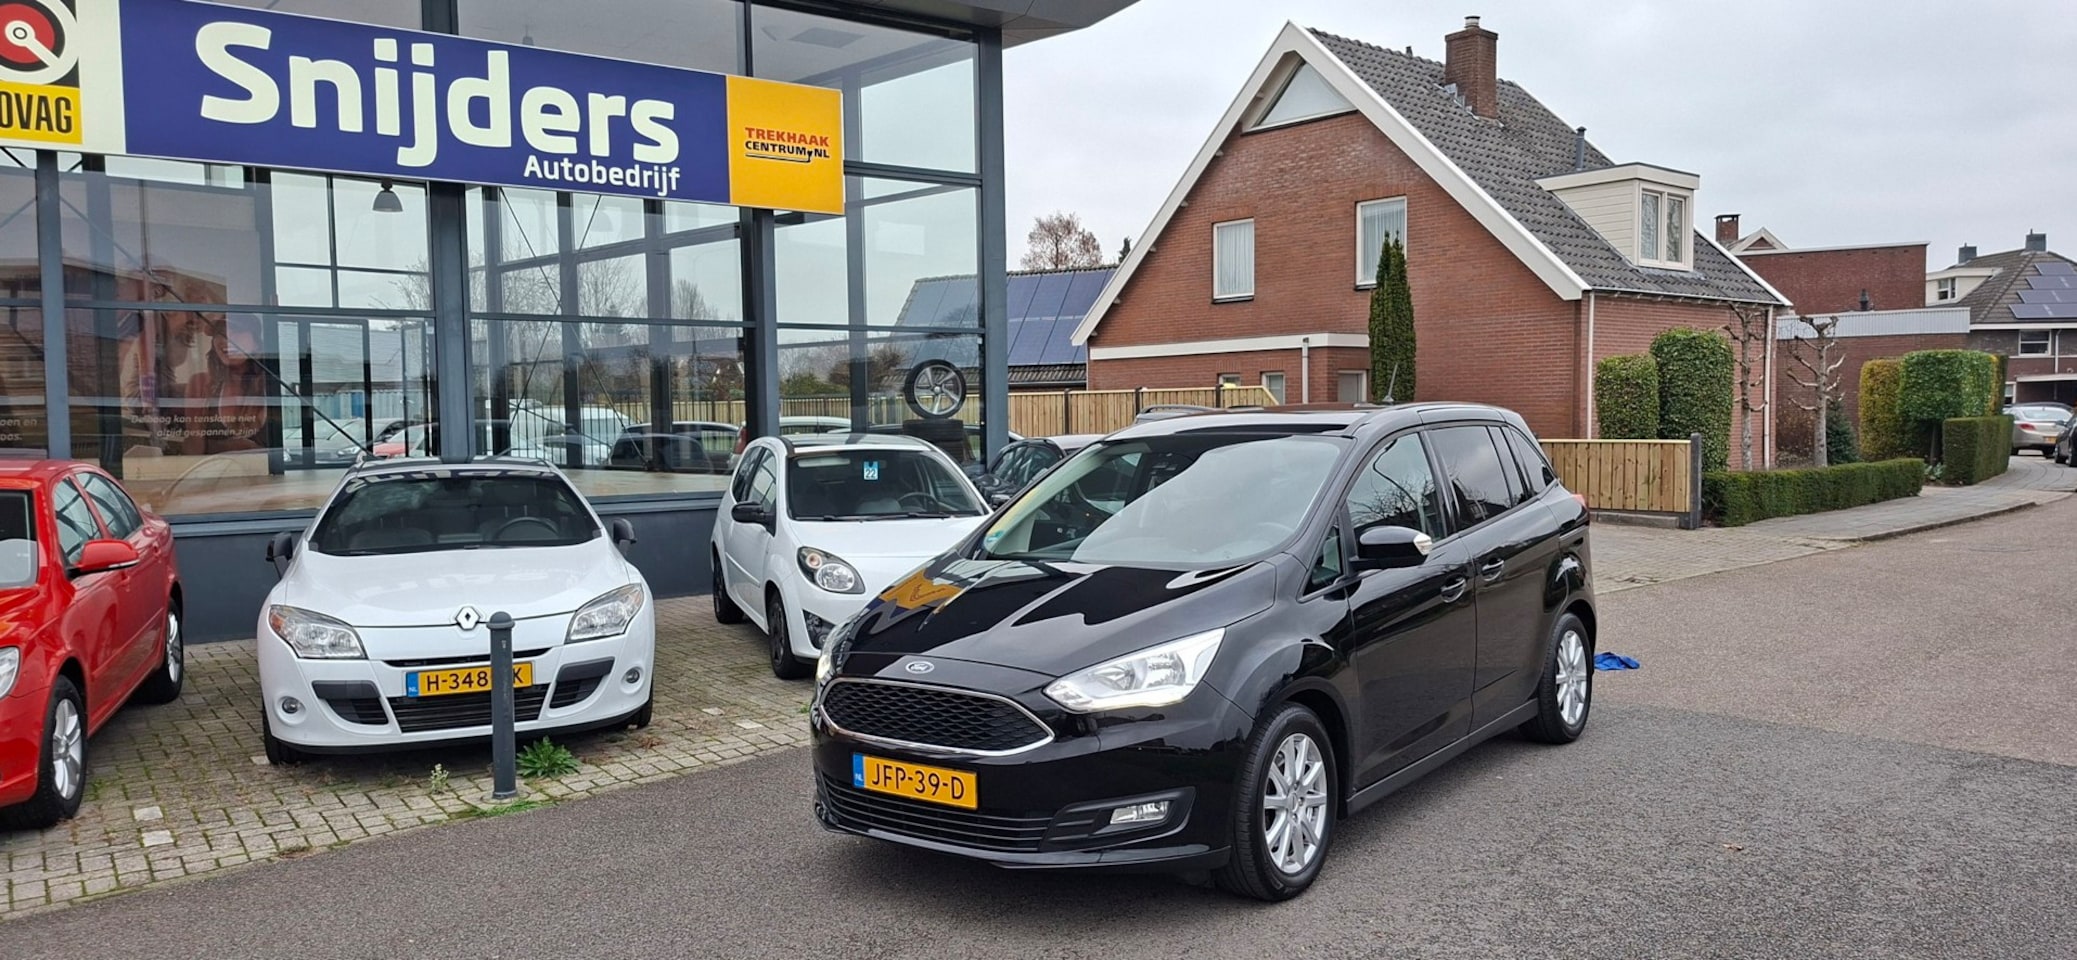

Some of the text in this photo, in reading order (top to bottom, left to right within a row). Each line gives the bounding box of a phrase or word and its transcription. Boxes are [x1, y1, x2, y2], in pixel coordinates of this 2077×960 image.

[195, 21, 680, 167] Snijders
[745, 127, 829, 147] TREKHAAK
[523, 155, 681, 196] Autobedrijf
[871, 763, 965, 800] JFP-39-D
